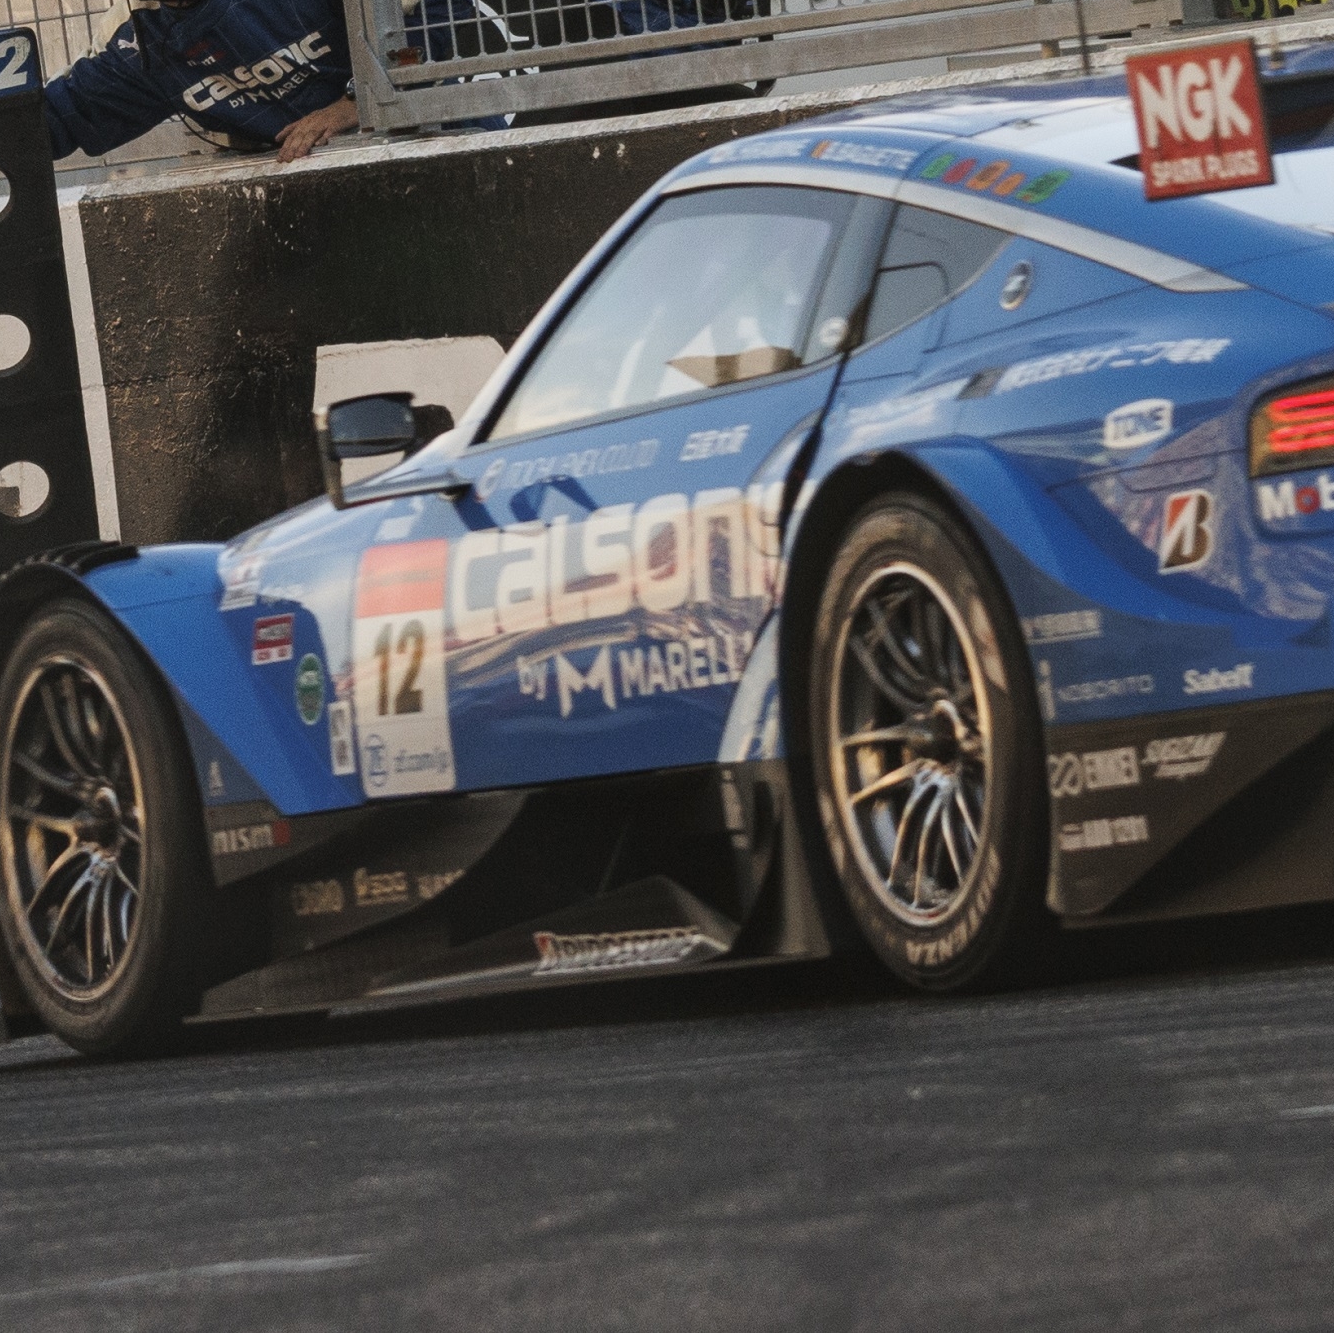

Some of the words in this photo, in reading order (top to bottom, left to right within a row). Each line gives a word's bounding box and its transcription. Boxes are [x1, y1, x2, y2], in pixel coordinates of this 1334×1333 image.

[228, 94, 247, 109] by
[1136, 53, 1252, 150] NGK
[1150, 156, 1205, 188] SPARK
[1204, 149, 1260, 180] PLUGS
[373, 619, 427, 716] 12
